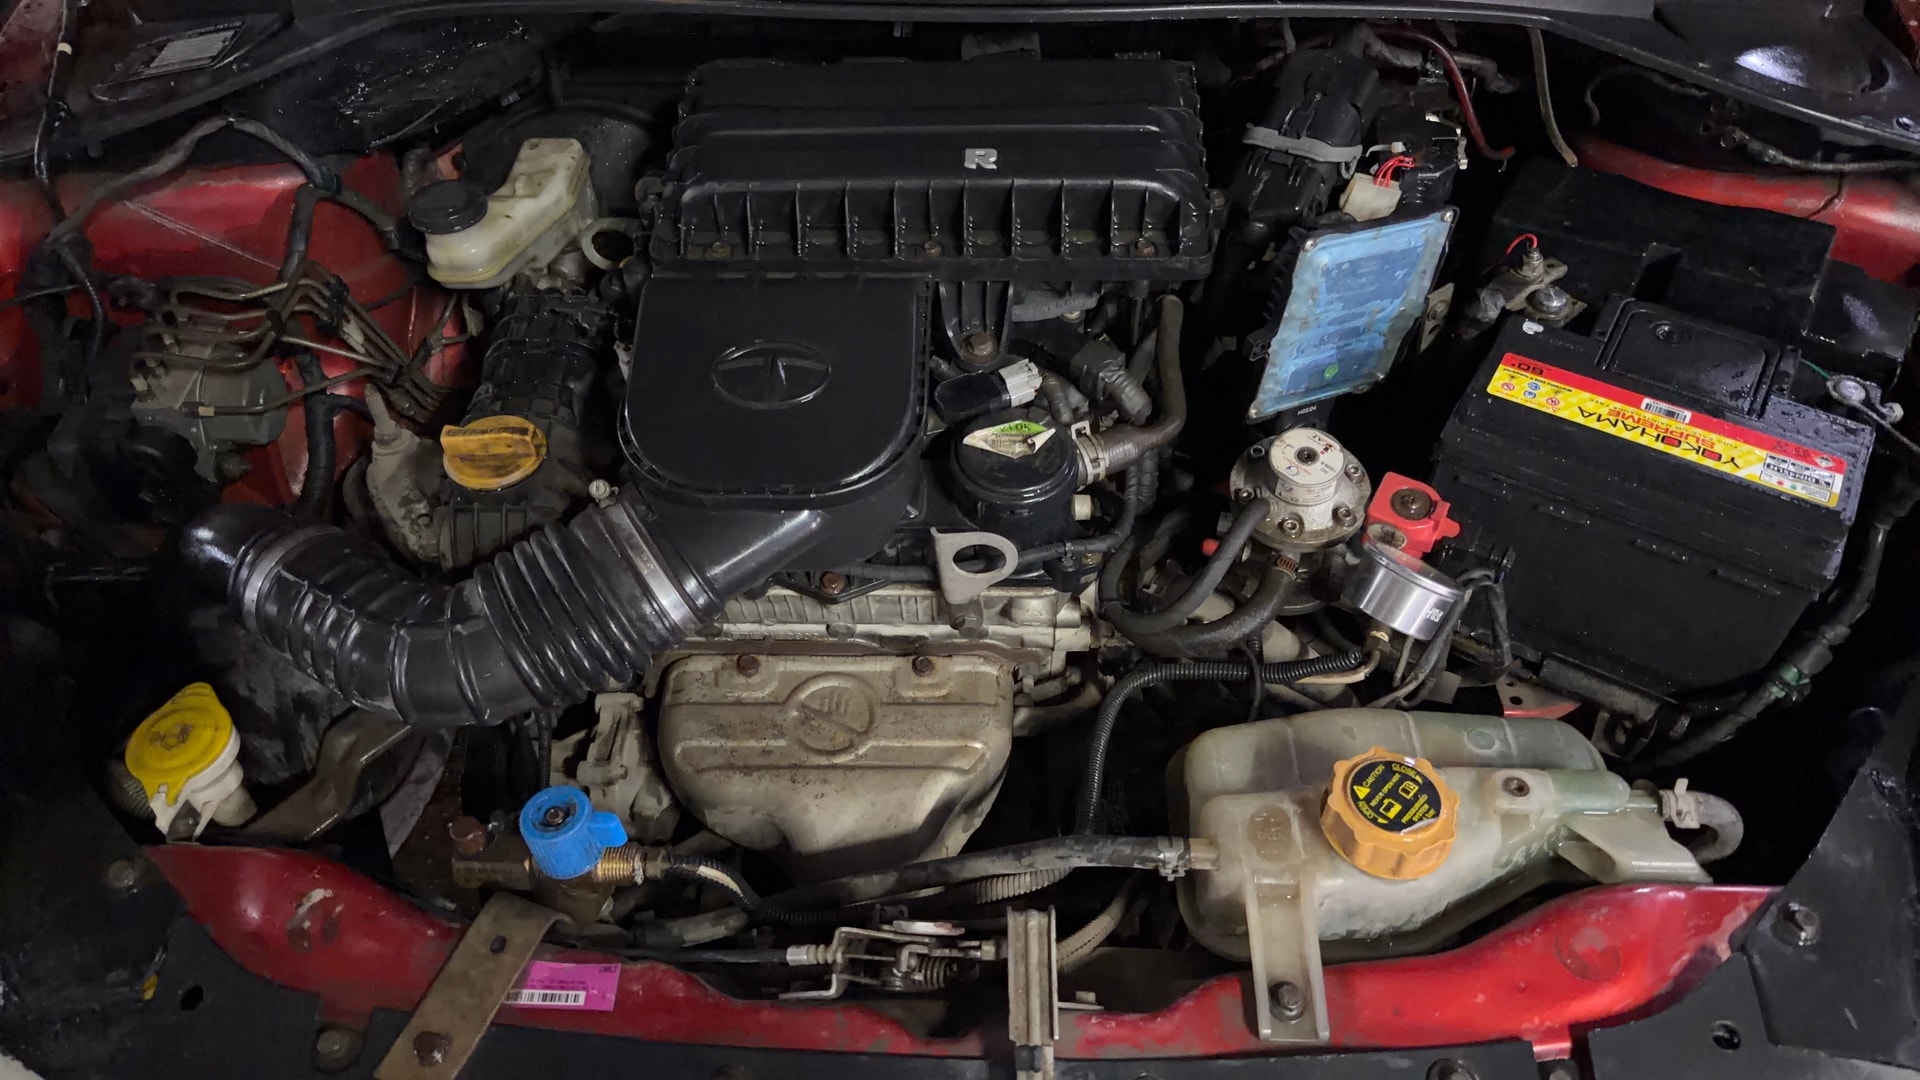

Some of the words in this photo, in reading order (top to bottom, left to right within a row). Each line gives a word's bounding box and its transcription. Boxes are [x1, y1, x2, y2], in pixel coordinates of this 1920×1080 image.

[964, 148, 998, 170] R
[1578, 406, 1741, 469] YOKOHAMA
[1607, 408, 1715, 449] SUPREME
[1362, 764, 1385, 787] CAUTION
[1392, 763, 1417, 777] CLOSE
[1381, 779, 1395, 794] OPEN
